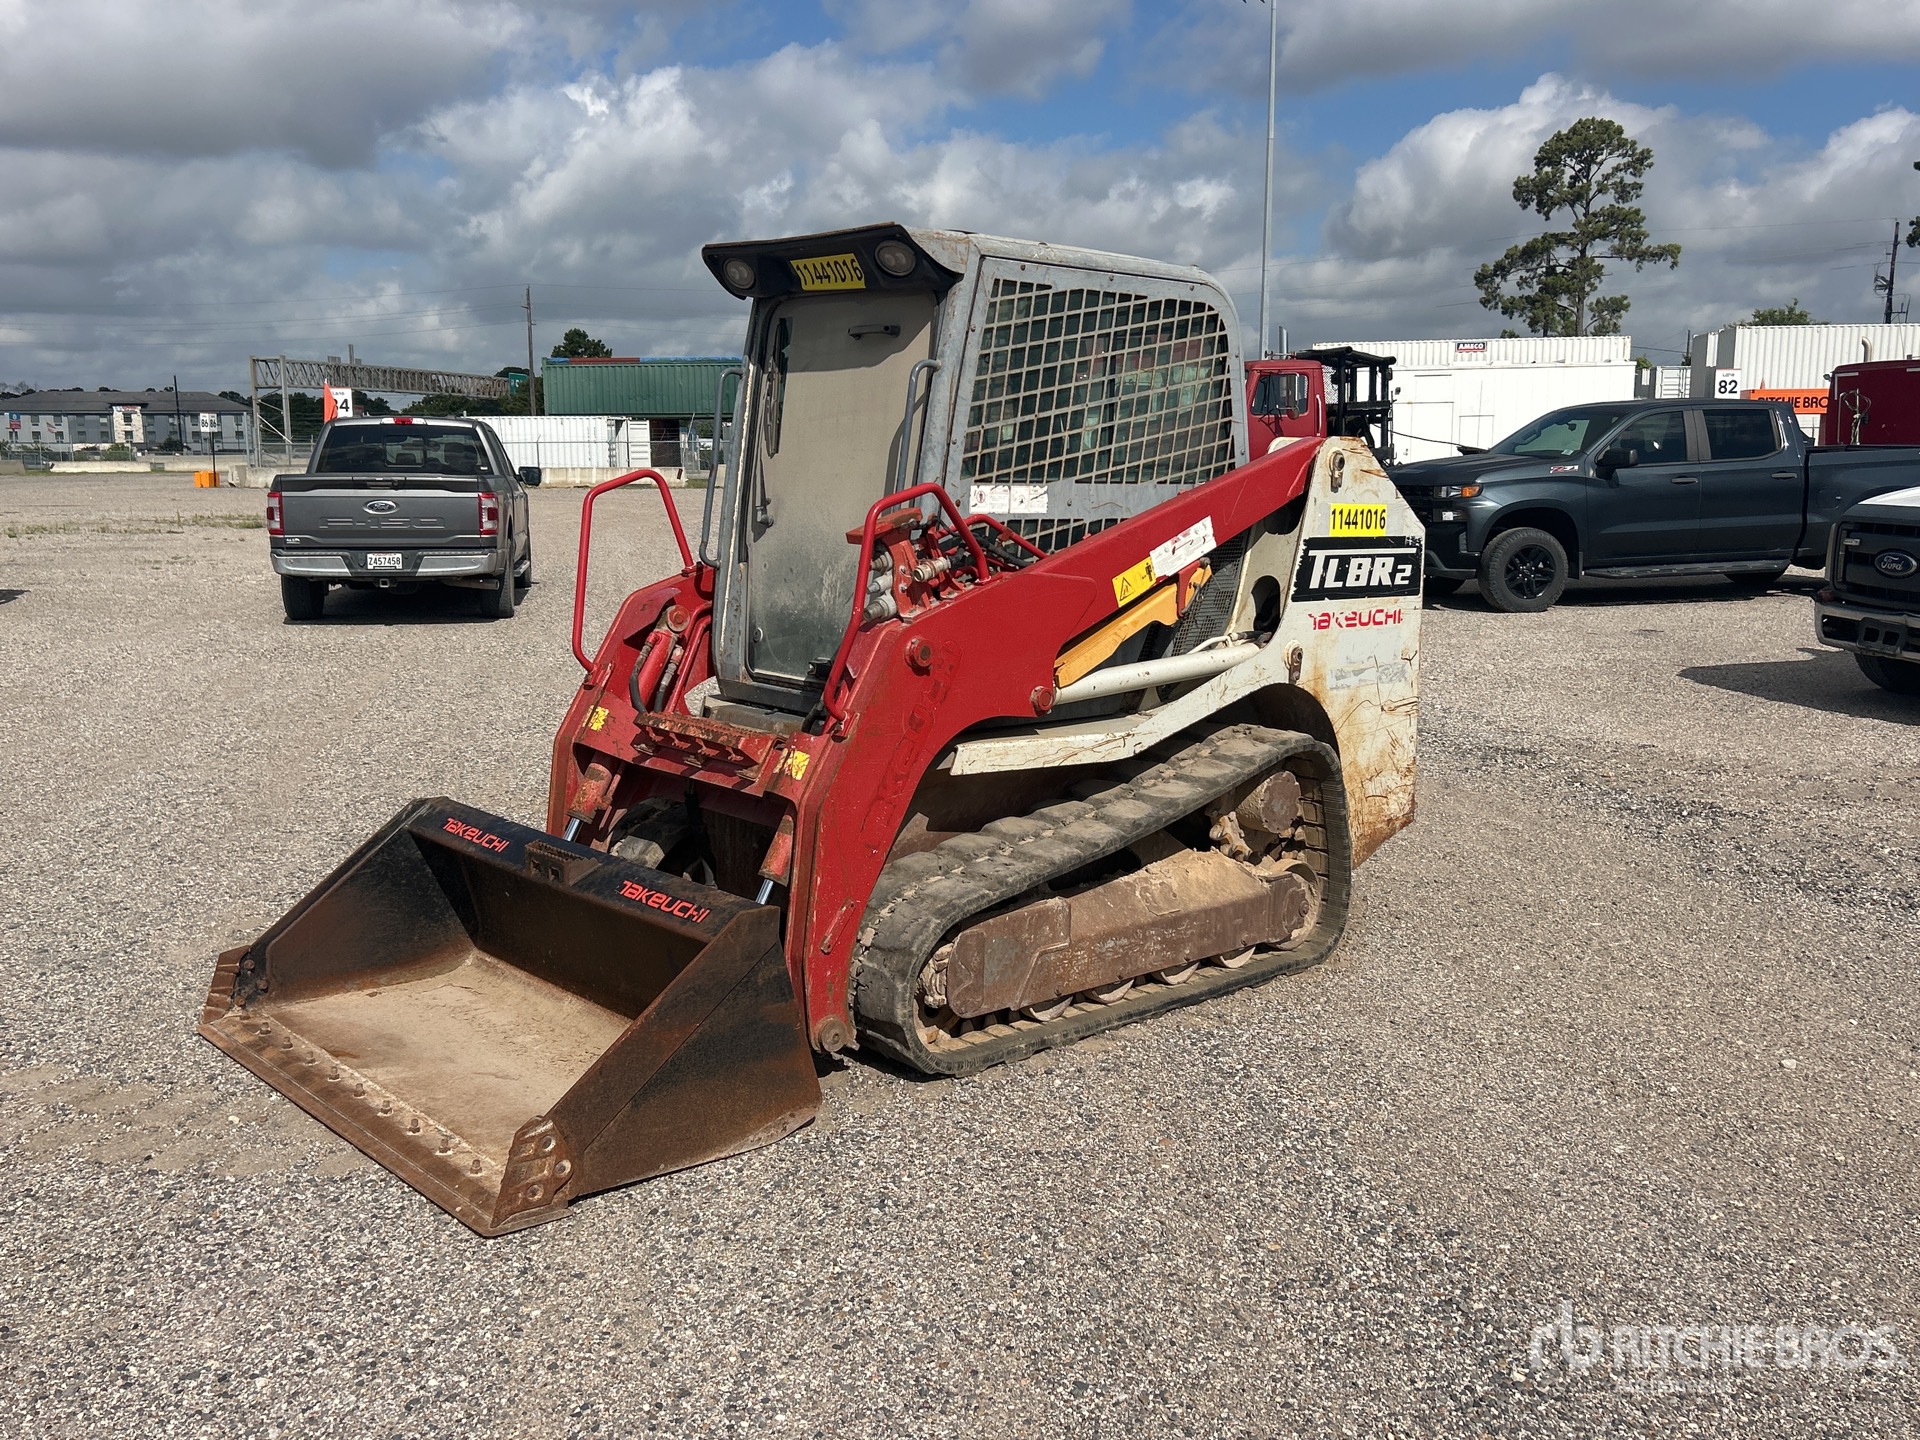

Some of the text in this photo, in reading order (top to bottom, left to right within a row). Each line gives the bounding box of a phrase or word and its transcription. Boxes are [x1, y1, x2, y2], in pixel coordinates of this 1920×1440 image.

[796, 259, 863, 286] 11441016
[1718, 380, 1738, 394] 82
[201, 418, 209, 428] 86
[1331, 508, 1386, 530] 11441016
[1881, 555, 1905, 571] Ford
